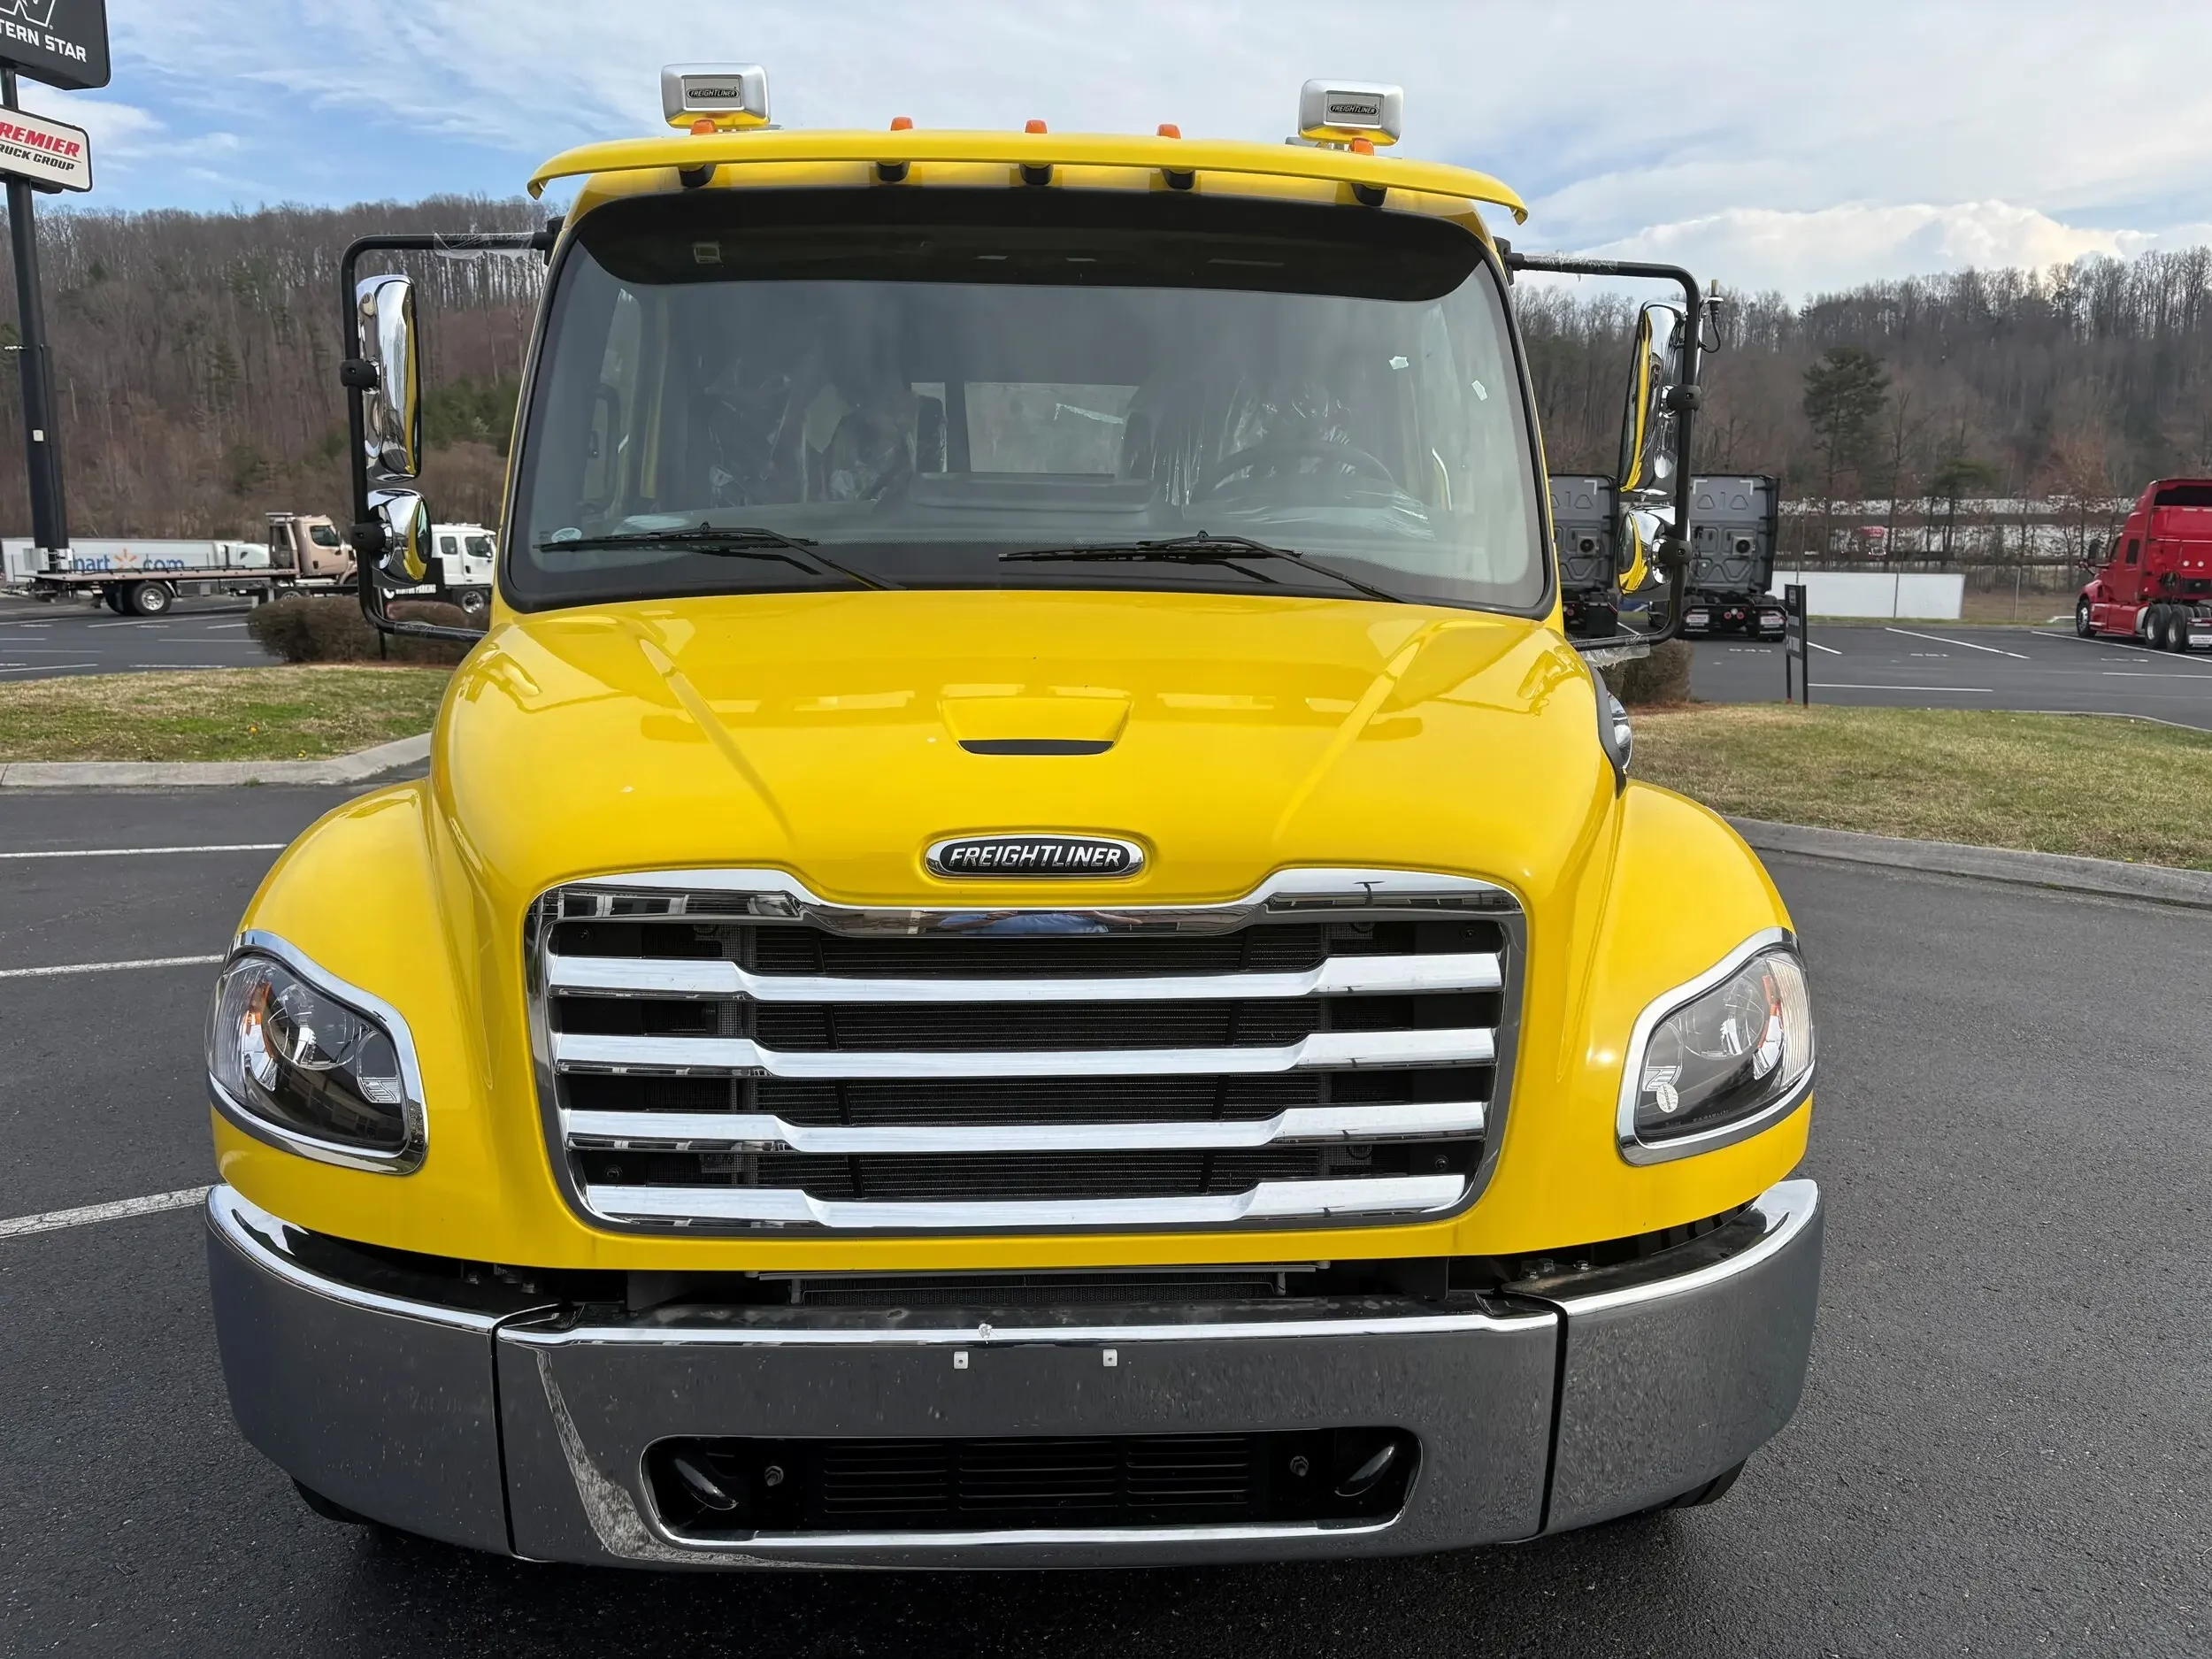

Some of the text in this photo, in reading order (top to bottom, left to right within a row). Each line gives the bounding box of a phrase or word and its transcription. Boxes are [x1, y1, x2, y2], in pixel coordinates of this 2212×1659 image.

[44, 34, 88, 64] STAR
[689, 88, 736, 97] FREIGHTLINER
[1331, 105, 1376, 114] FREIGHTLINER
[0, 121, 81, 157] REMIER
[33, 153, 75, 171] GROUP
[949, 845, 1122, 867] FREIGHTLINER
